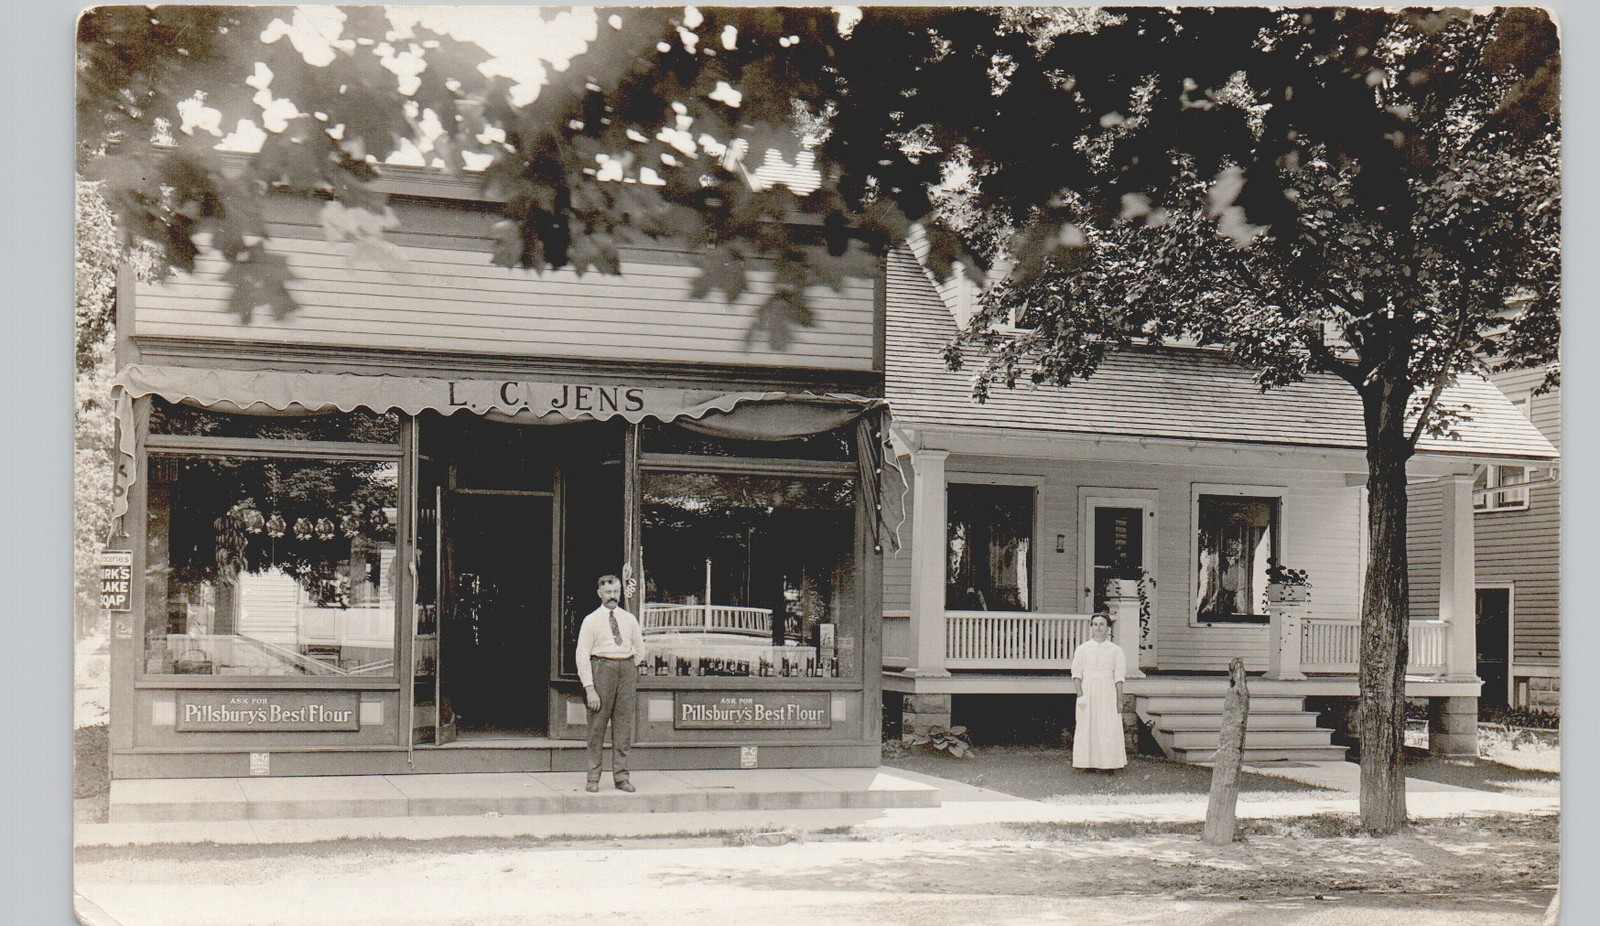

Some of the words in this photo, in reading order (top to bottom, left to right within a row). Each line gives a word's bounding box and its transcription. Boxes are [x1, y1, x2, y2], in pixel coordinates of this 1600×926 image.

[448, 381, 476, 409] L.
[500, 381, 528, 406] C.
[551, 384, 644, 412] JENS
[101, 581, 128, 593] LAKE
[184, 704, 267, 725] Pillsbury's
[269, 704, 306, 723] Best
[308, 704, 352, 723] Flour
[681, 704, 752, 723] Pillsbury's
[754, 703, 785, 721] Best
[786, 703, 824, 721] Flour
